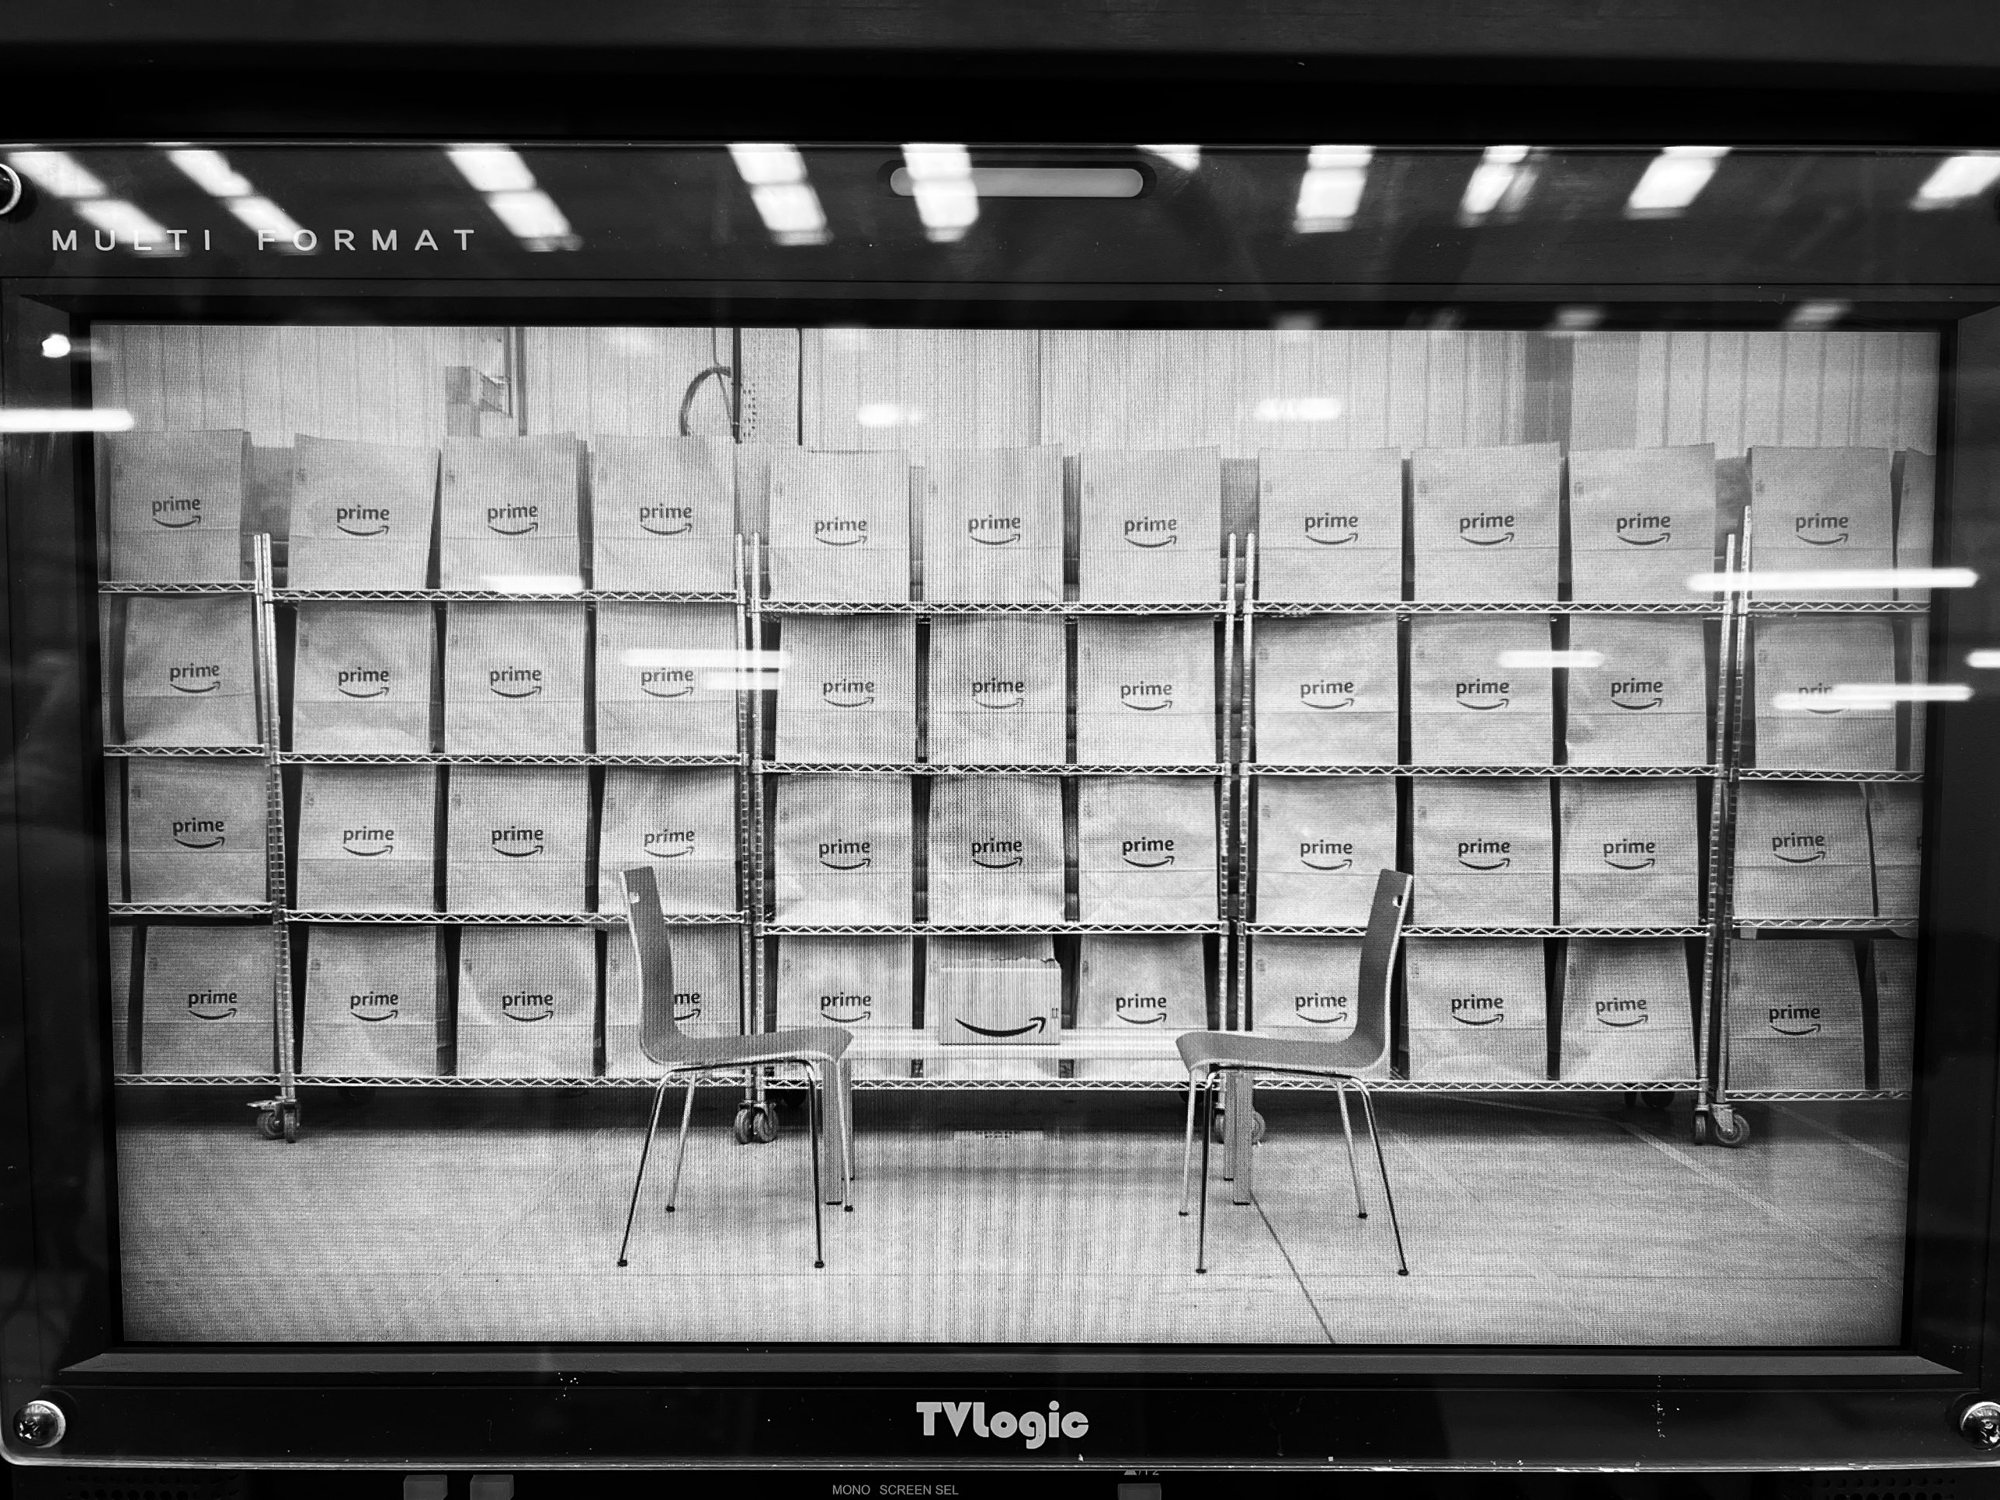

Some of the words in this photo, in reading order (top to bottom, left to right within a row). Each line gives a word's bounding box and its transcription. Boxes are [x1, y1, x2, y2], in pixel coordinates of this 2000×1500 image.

[52, 229, 211, 251] MULTI
[258, 229, 475, 251] FORMAT
[152, 497, 201, 515] prime
[336, 505, 389, 523] prime
[488, 504, 538, 522] prime
[640, 504, 692, 522] prime
[814, 517, 867, 535] prime
[968, 514, 1020, 533] prime
[1124, 517, 1176, 535] prime
[1305, 514, 1358, 532] prime
[1460, 513, 1515, 532] prime
[1617, 513, 1670, 532] prime
[1796, 512, 1849, 530] prime
[169, 662, 219, 681] prime
[338, 666, 390, 685] prime
[490, 667, 541, 686] prime
[641, 668, 694, 686] prime
[823, 677, 874, 695] prime
[972, 677, 1024, 695] prime
[1120, 680, 1172, 698] prime
[1301, 679, 1354, 697] prime
[1455, 679, 1509, 697] prime
[1611, 678, 1663, 696] prime
[172, 818, 223, 837] prime
[343, 826, 394, 844] prime
[492, 826, 543, 844] prime
[645, 826, 695, 845] prime
[819, 838, 871, 857] prime
[971, 838, 1022, 856] prime
[1122, 837, 1174, 855] prime
[1300, 838, 1353, 856] prime
[1458, 839, 1511, 857] prime
[1604, 839, 1656, 857] prime
[1772, 832, 1825, 850] prime
[187, 990, 236, 1009] prime
[350, 991, 398, 1009] prime
[502, 991, 553, 1009] prime
[820, 992, 871, 1010] prime
[1115, 994, 1167, 1012] prime
[1295, 992, 1347, 1011] prime
[1451, 995, 1503, 1013] prime
[1596, 996, 1647, 1014] prime
[1769, 1004, 1821, 1022] prime
[916, 1400, 1089, 1449] TVLogic
[832, 1485, 871, 1496] MONO
[879, 1485, 932, 1496] SCREEN
[935, 1485, 959, 1496] SEL
